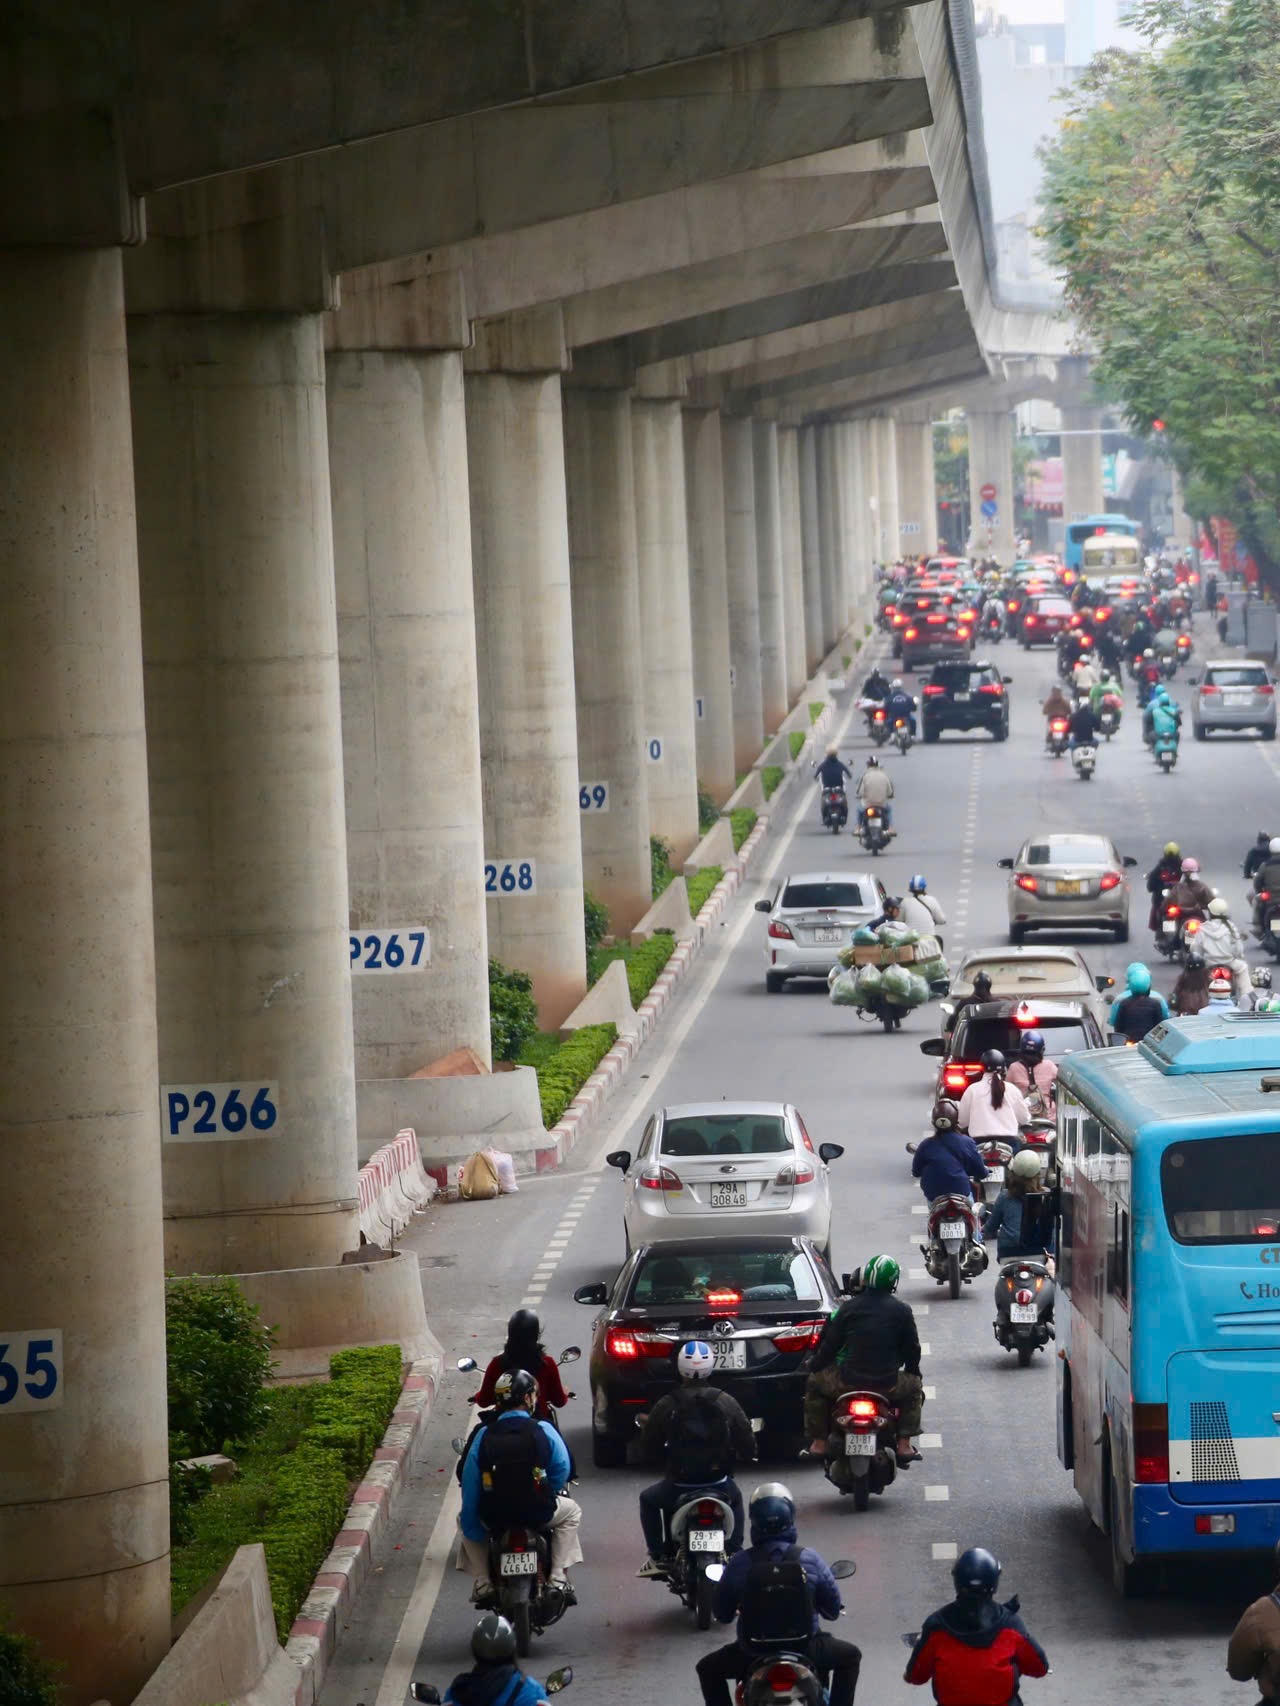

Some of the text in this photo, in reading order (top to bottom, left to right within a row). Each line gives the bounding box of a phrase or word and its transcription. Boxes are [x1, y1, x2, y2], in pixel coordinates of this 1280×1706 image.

[485, 863, 532, 892] 268
[349, 932, 425, 969] P267
[168, 1087, 277, 1135] P266
[720, 1184, 738, 1194] 29A
[713, 1194, 746, 1206] 308.48
[712, 1341, 734, 1354] 30A
